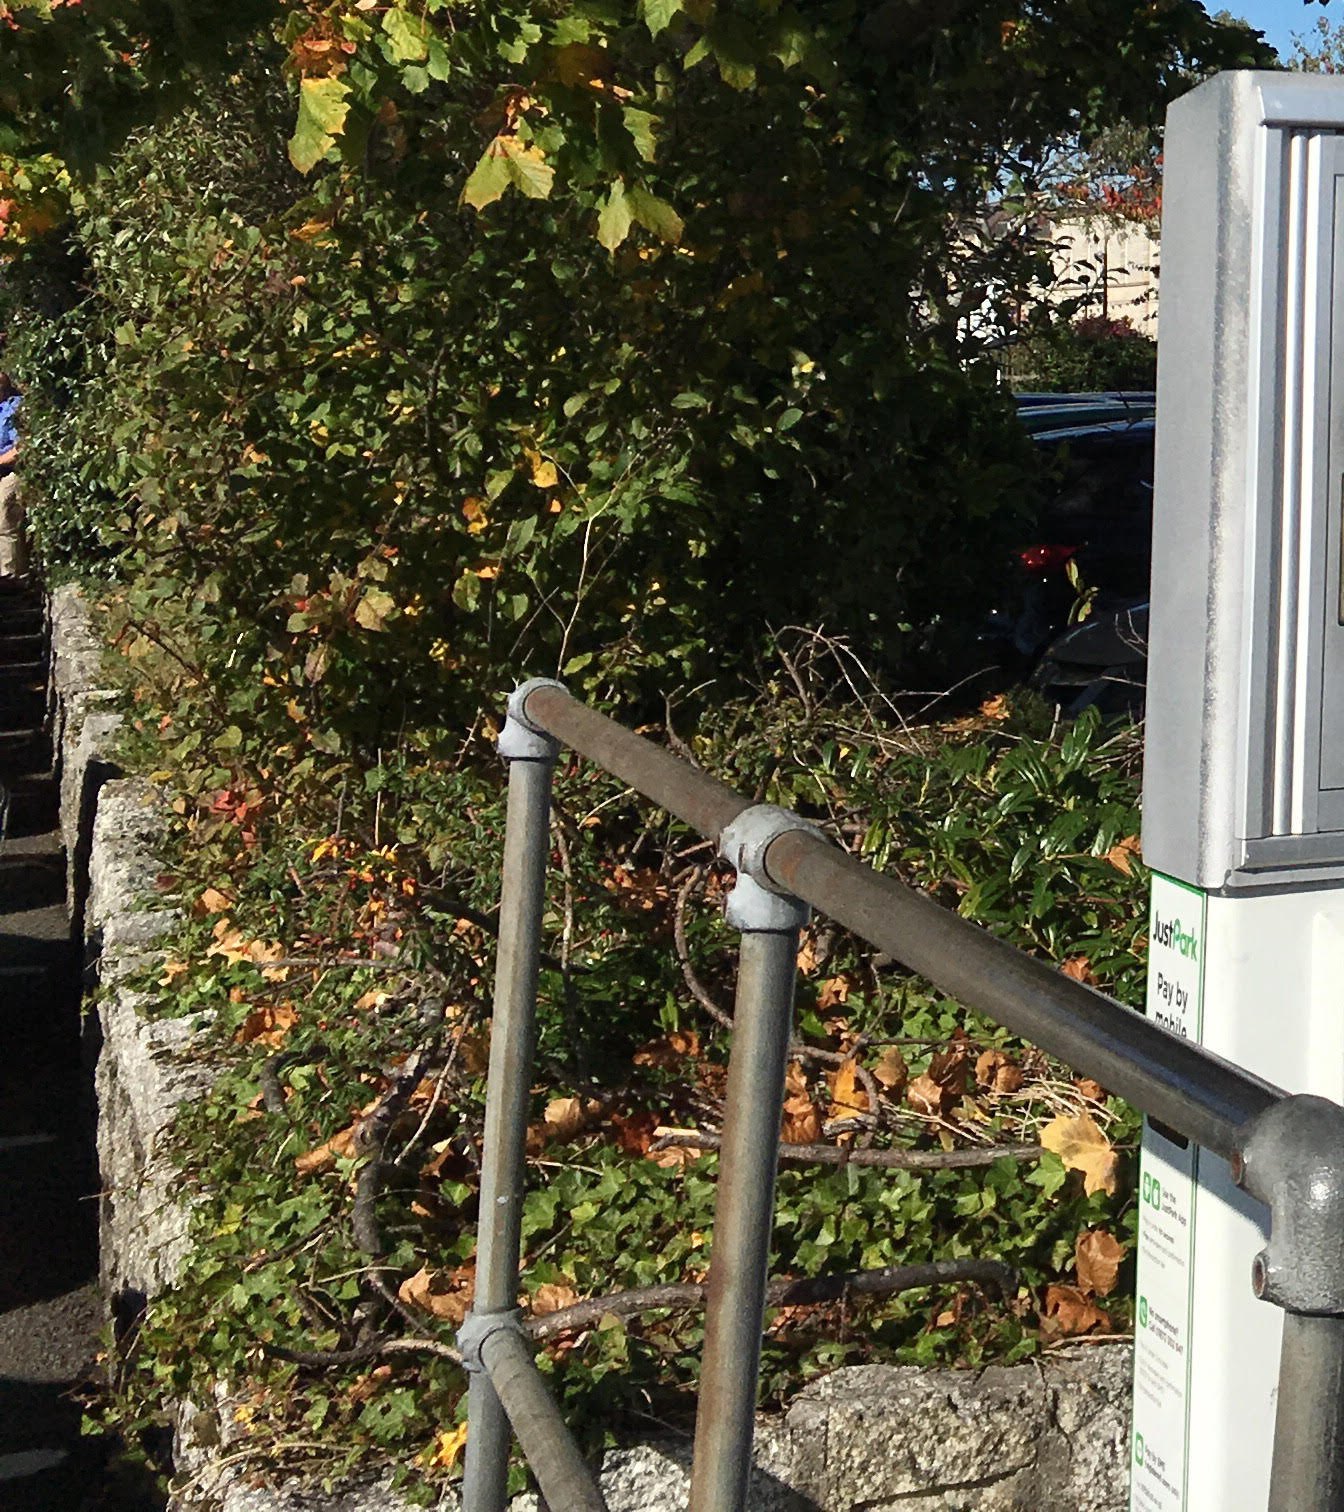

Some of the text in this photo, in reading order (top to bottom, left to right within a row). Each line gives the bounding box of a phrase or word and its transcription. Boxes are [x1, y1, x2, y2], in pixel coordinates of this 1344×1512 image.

[1153, 909, 1198, 962] JustPark
[1157, 972, 1189, 1014] Pay by
